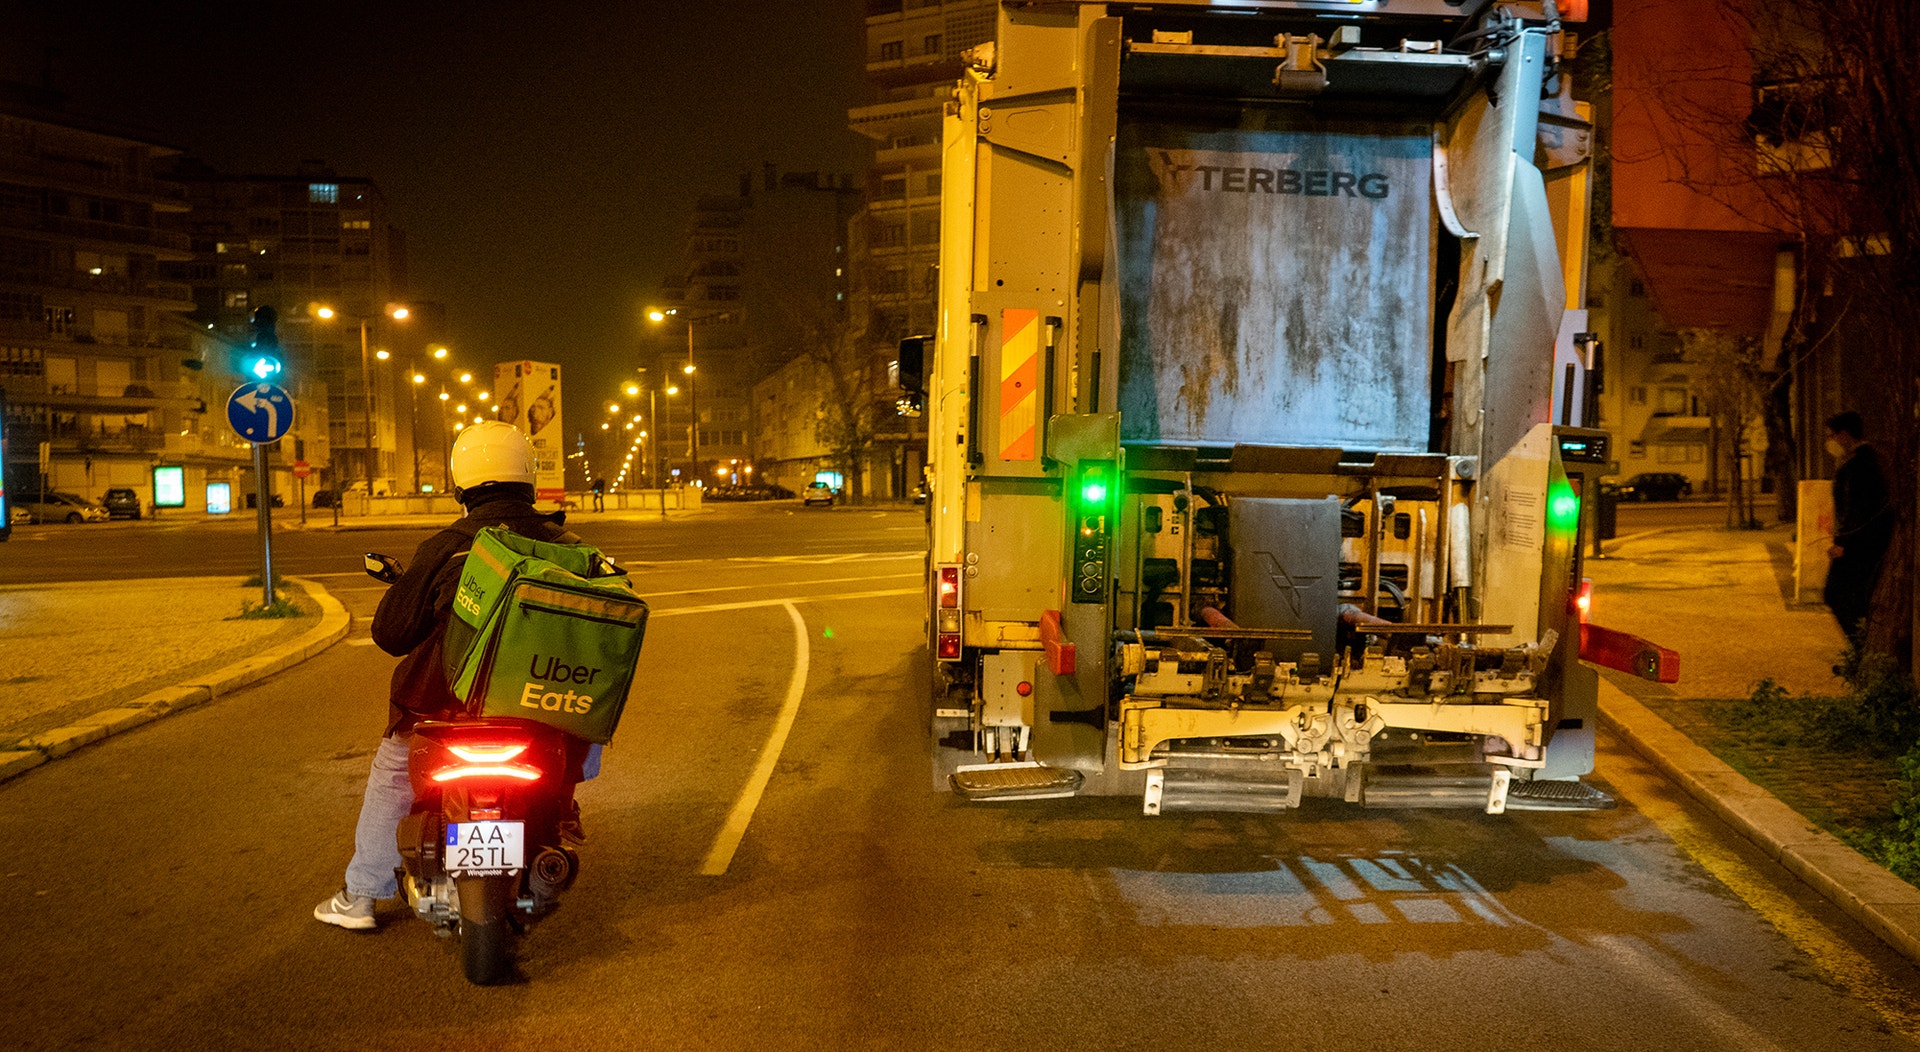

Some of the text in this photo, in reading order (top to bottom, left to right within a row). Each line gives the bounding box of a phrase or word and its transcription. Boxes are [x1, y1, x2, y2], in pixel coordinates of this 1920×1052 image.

[1195, 165, 1389, 199] TERBERG
[463, 571, 485, 599] Uber
[456, 586, 480, 616] Eats
[529, 654, 602, 685] Uber
[520, 682, 593, 714] Eats
[467, 825, 505, 844] AA
[457, 847, 513, 867] 25TL
